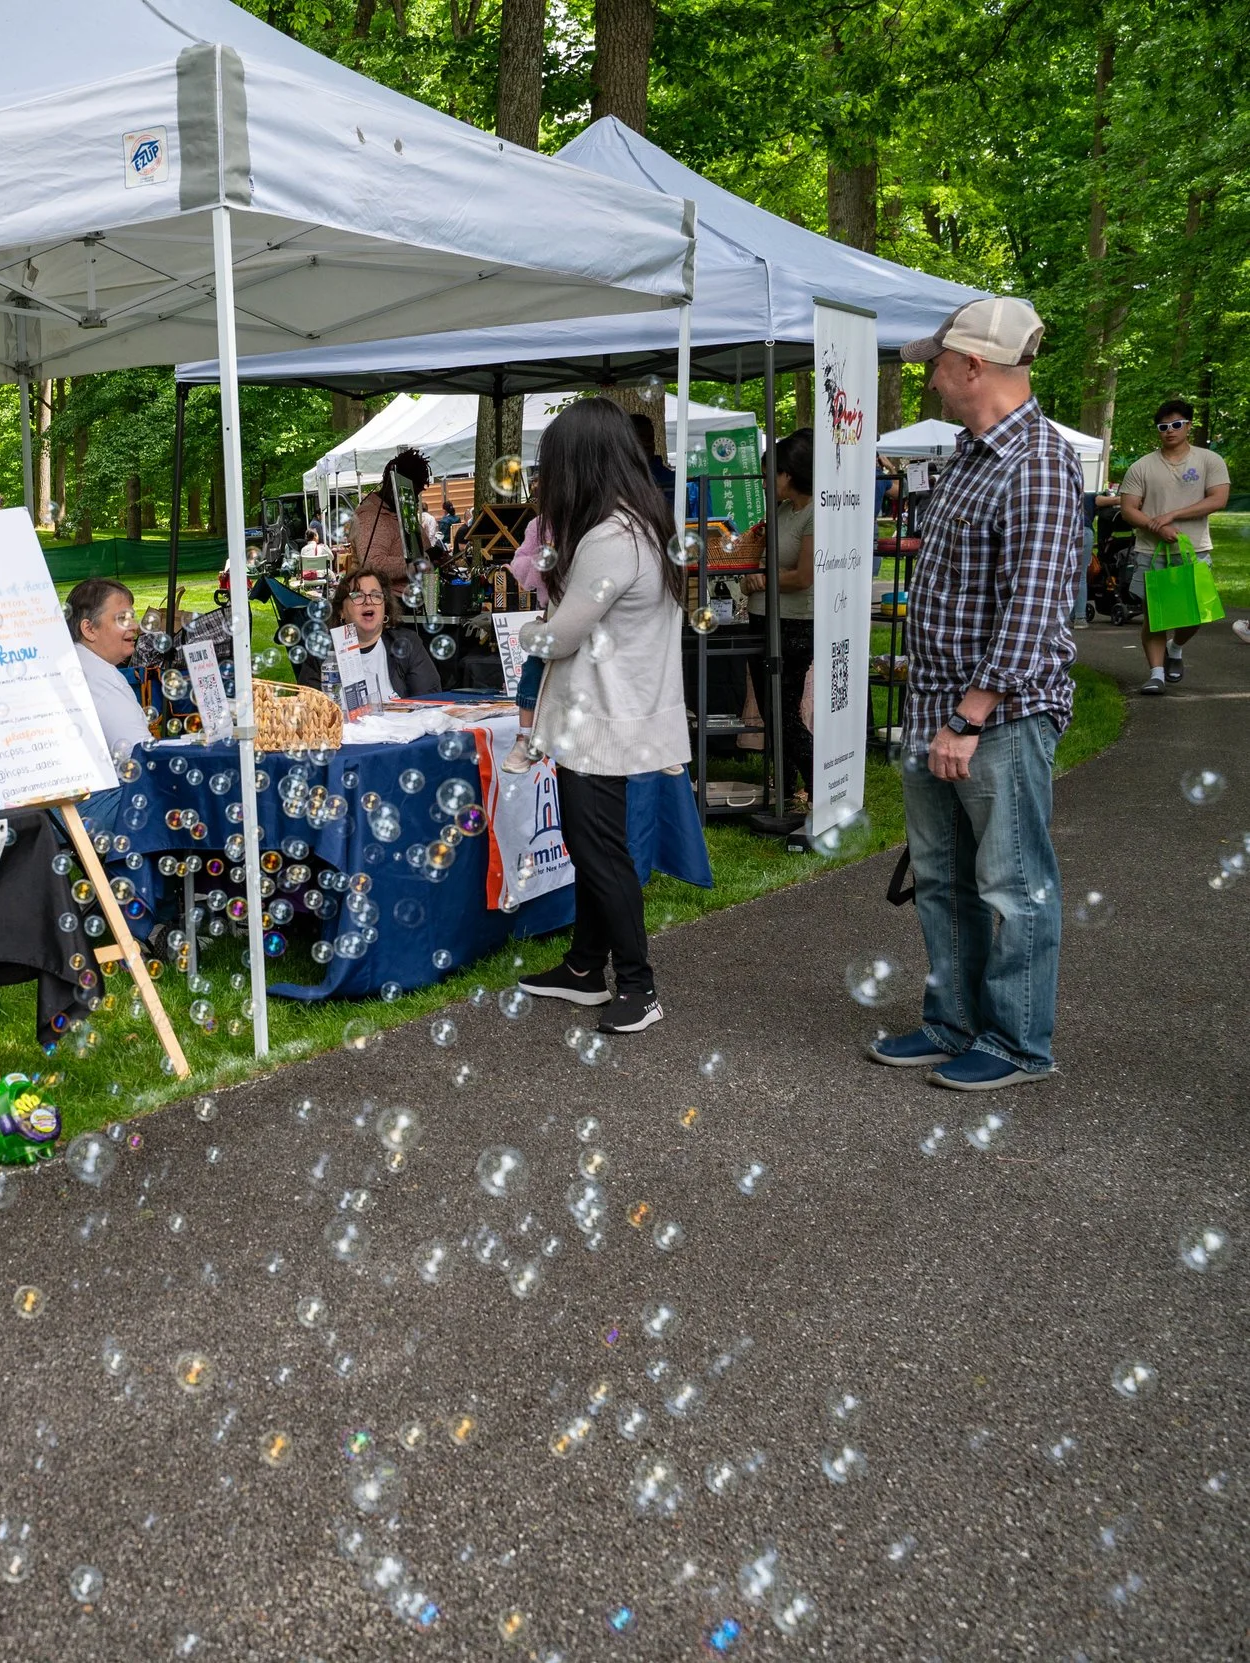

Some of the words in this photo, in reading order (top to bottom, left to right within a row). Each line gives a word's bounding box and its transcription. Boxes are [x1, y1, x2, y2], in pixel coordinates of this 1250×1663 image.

[743, 472, 753, 509] Bltimore
[820, 490, 842, 511] Simply
[843, 490, 860, 511] Unique
[189, 650, 203, 664] FOLLOW
[202, 649, 209, 660] US
[495, 616, 519, 692] DONATE
[546, 865, 558, 873] New
